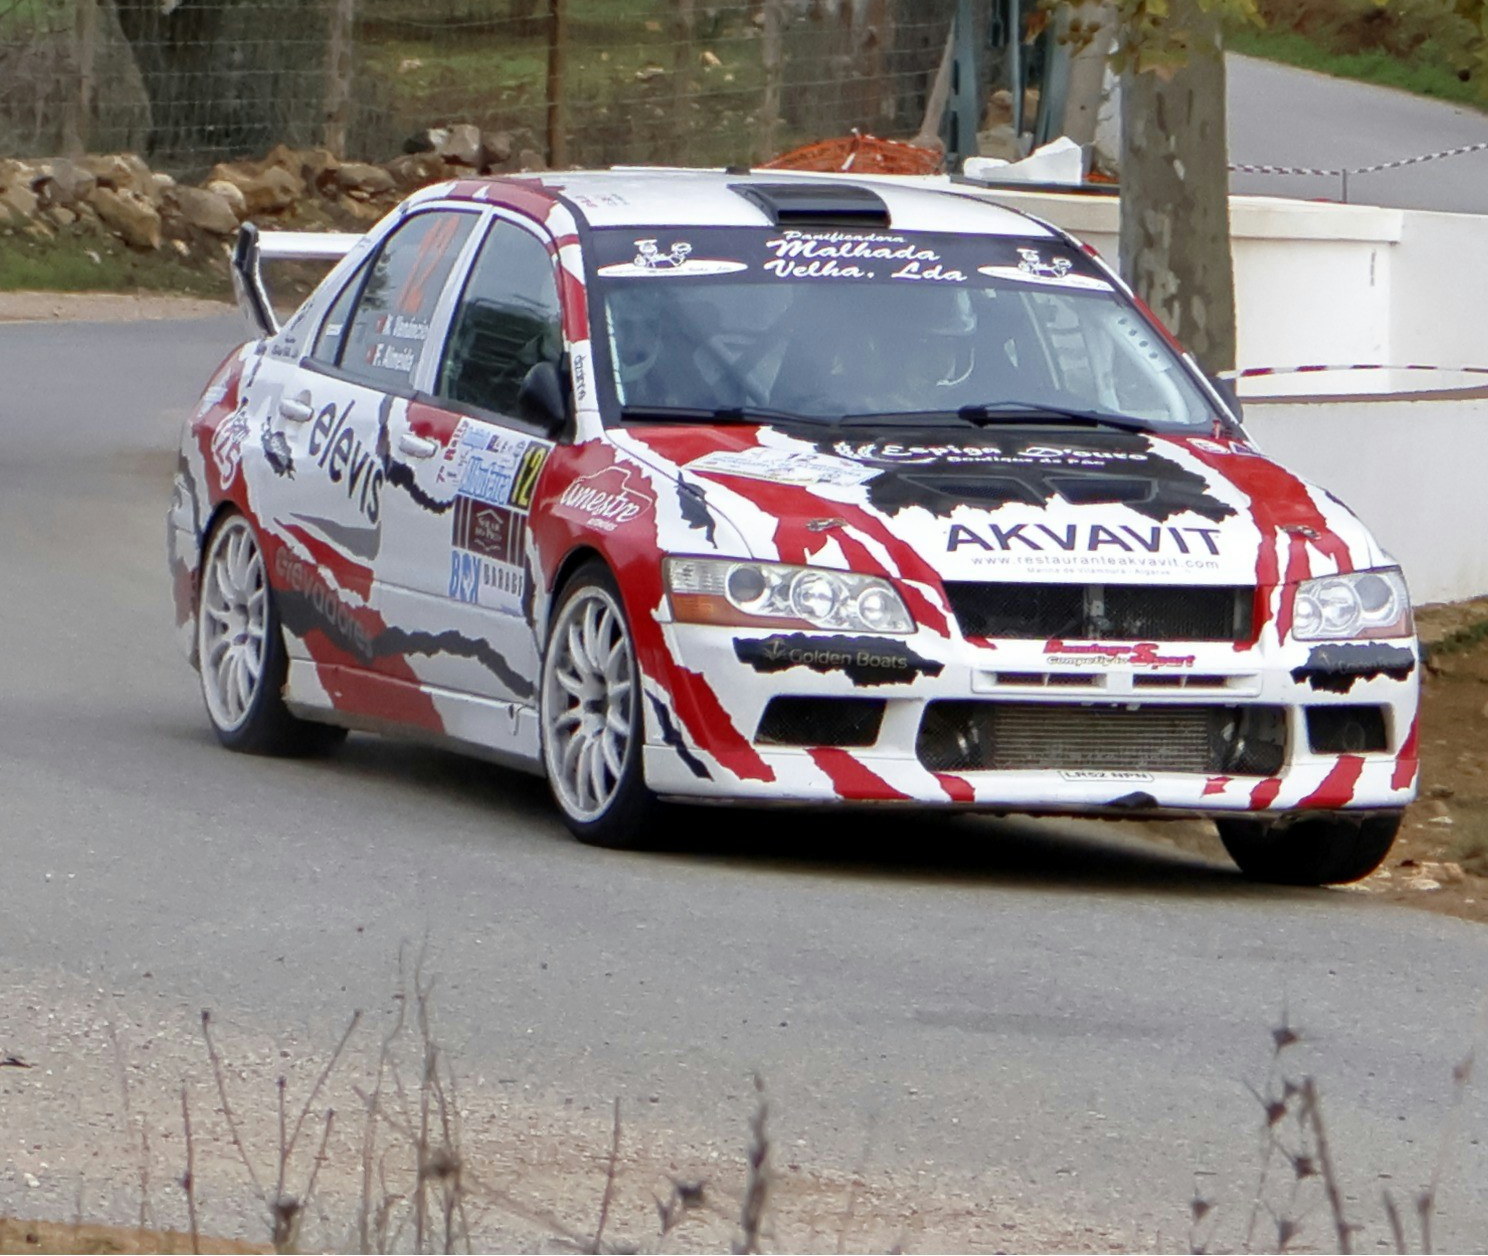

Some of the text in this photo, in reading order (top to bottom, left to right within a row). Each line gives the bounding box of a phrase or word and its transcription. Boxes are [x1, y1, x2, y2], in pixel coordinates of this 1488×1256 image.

[783, 230, 907, 243] Panificadora
[766, 240, 940, 261] Malhada
[891, 261, 968, 281] Lda
[309, 399, 383, 525] elevis
[512, 445, 547, 506] 12
[946, 523, 1221, 556] AKVAVIT
[971, 555, 1220, 570] www.restauranteakvavit.com
[448, 550, 482, 605] BOX
[789, 647, 908, 669] Golden Boats
